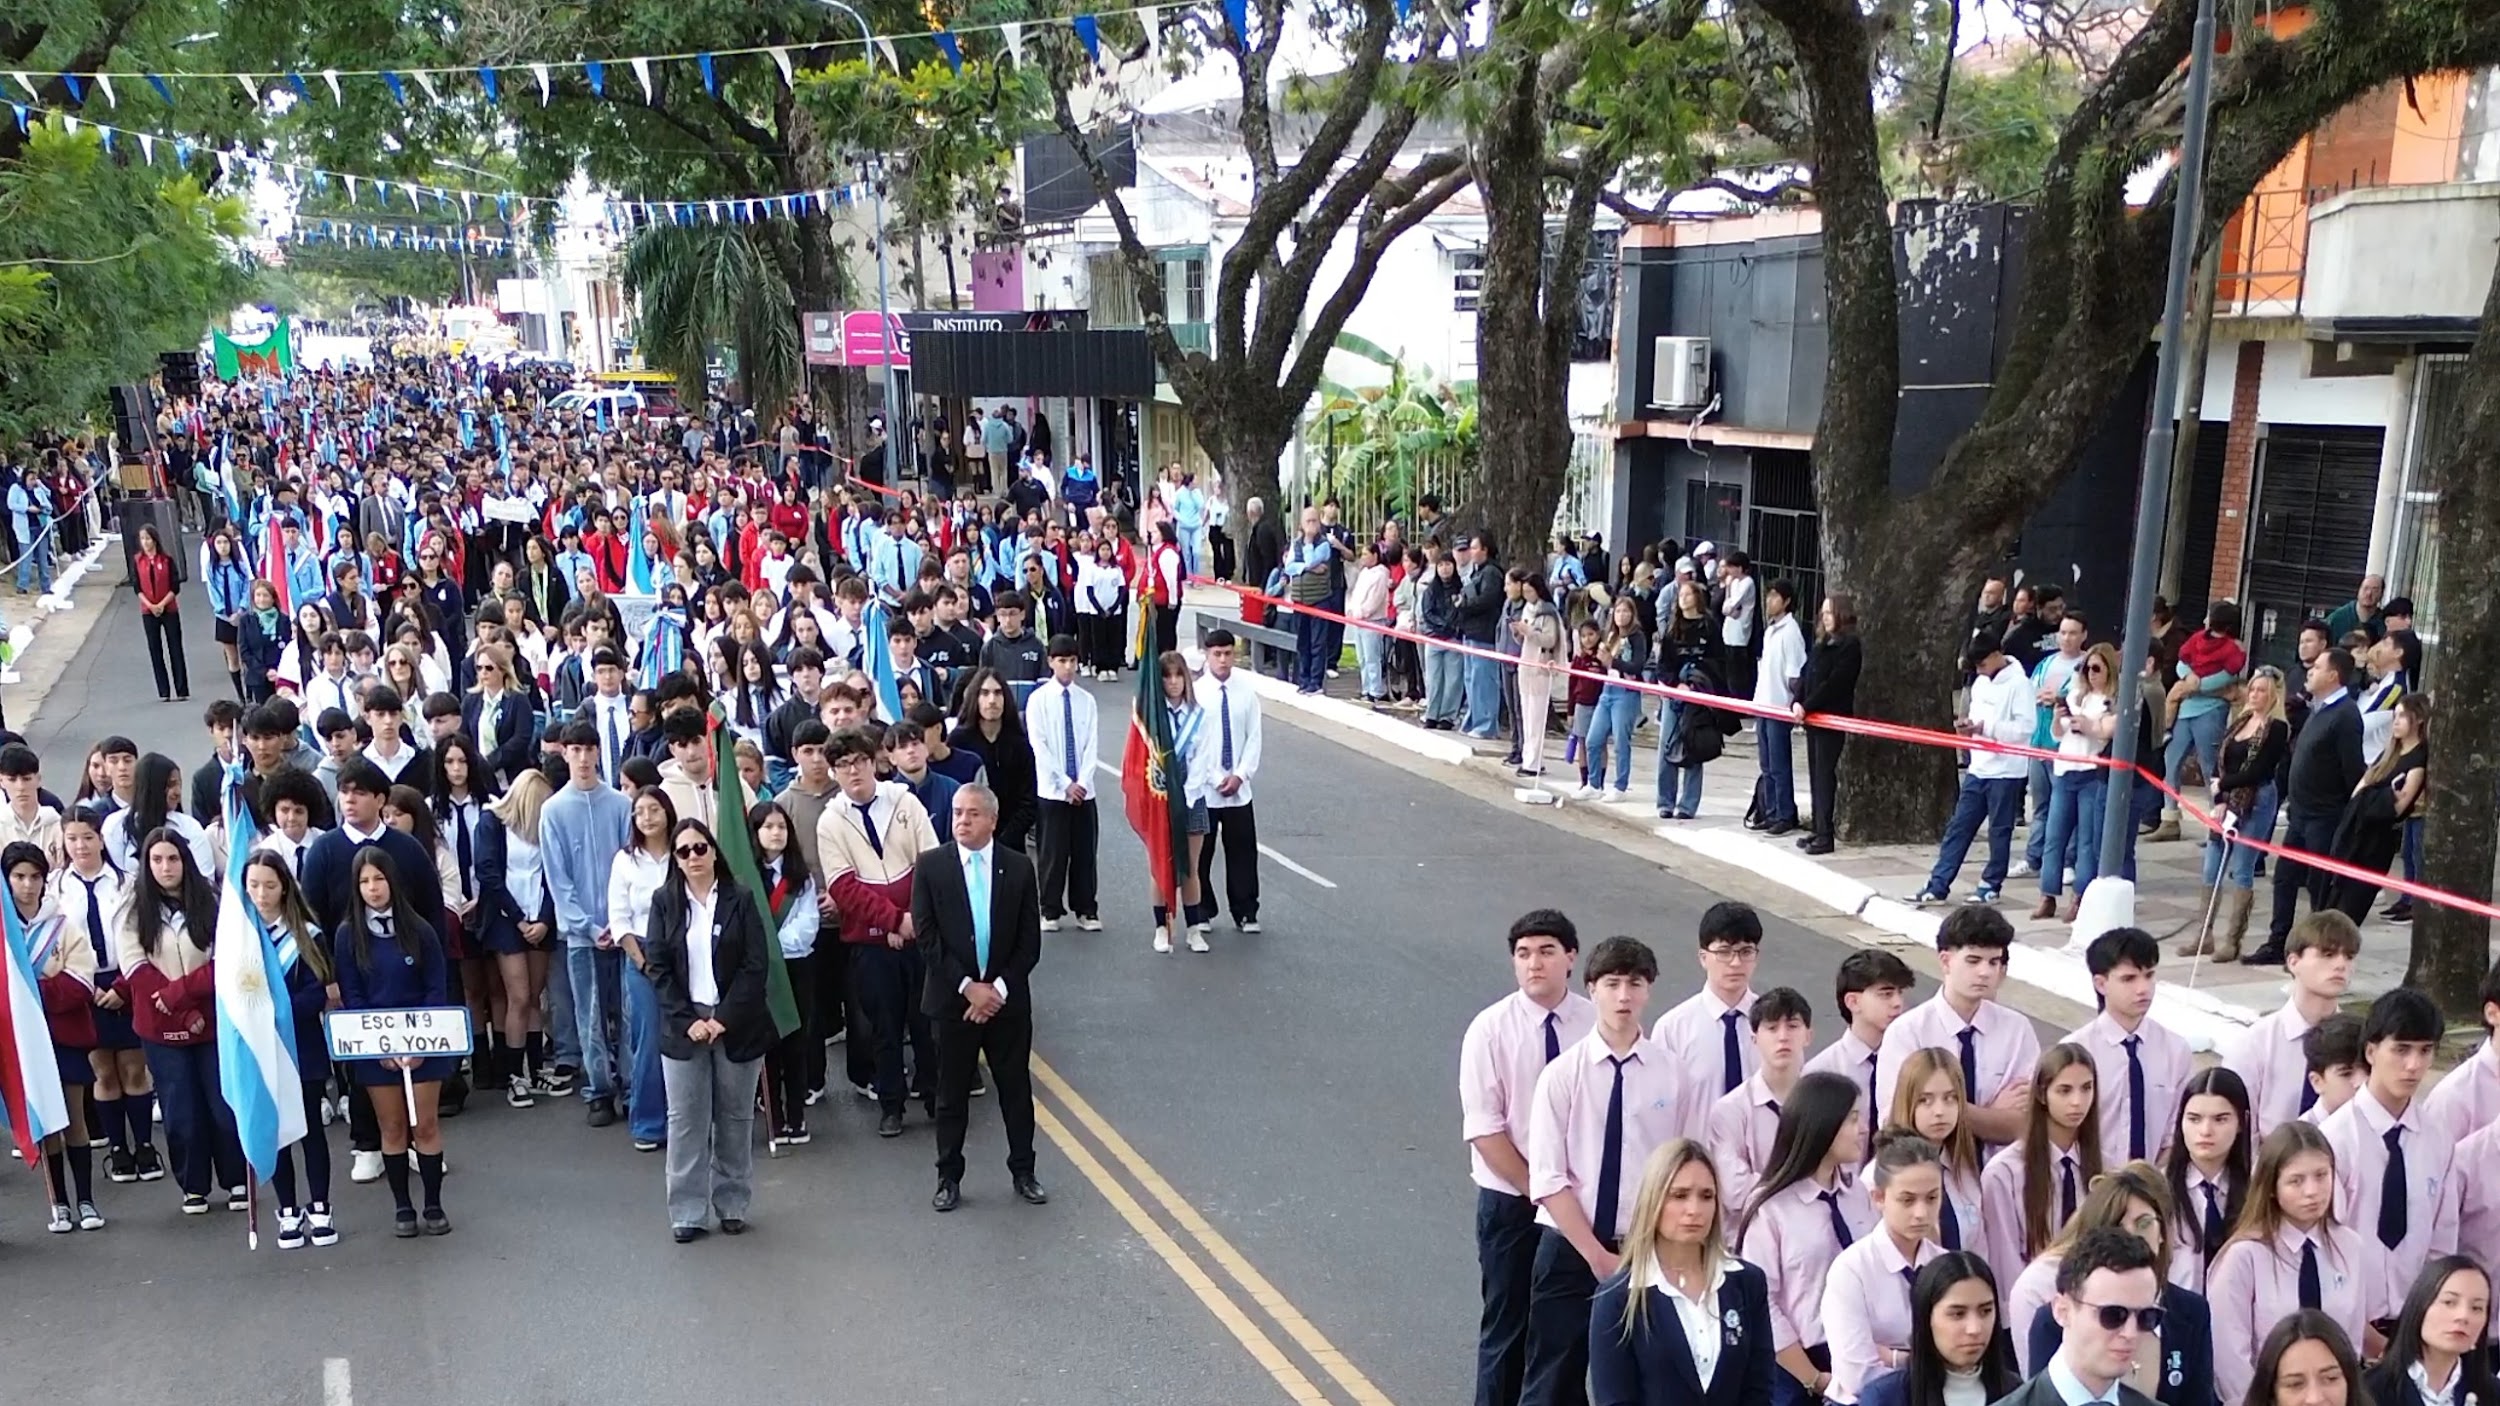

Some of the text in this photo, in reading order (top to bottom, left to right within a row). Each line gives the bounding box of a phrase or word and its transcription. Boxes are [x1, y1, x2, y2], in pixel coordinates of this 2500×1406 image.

[933, 318, 1003, 331] INSTITUTO
[361, 1014, 395, 1030] ESC
[338, 1038, 369, 1054] INT.
[402, 1035, 451, 1051] YOYA
